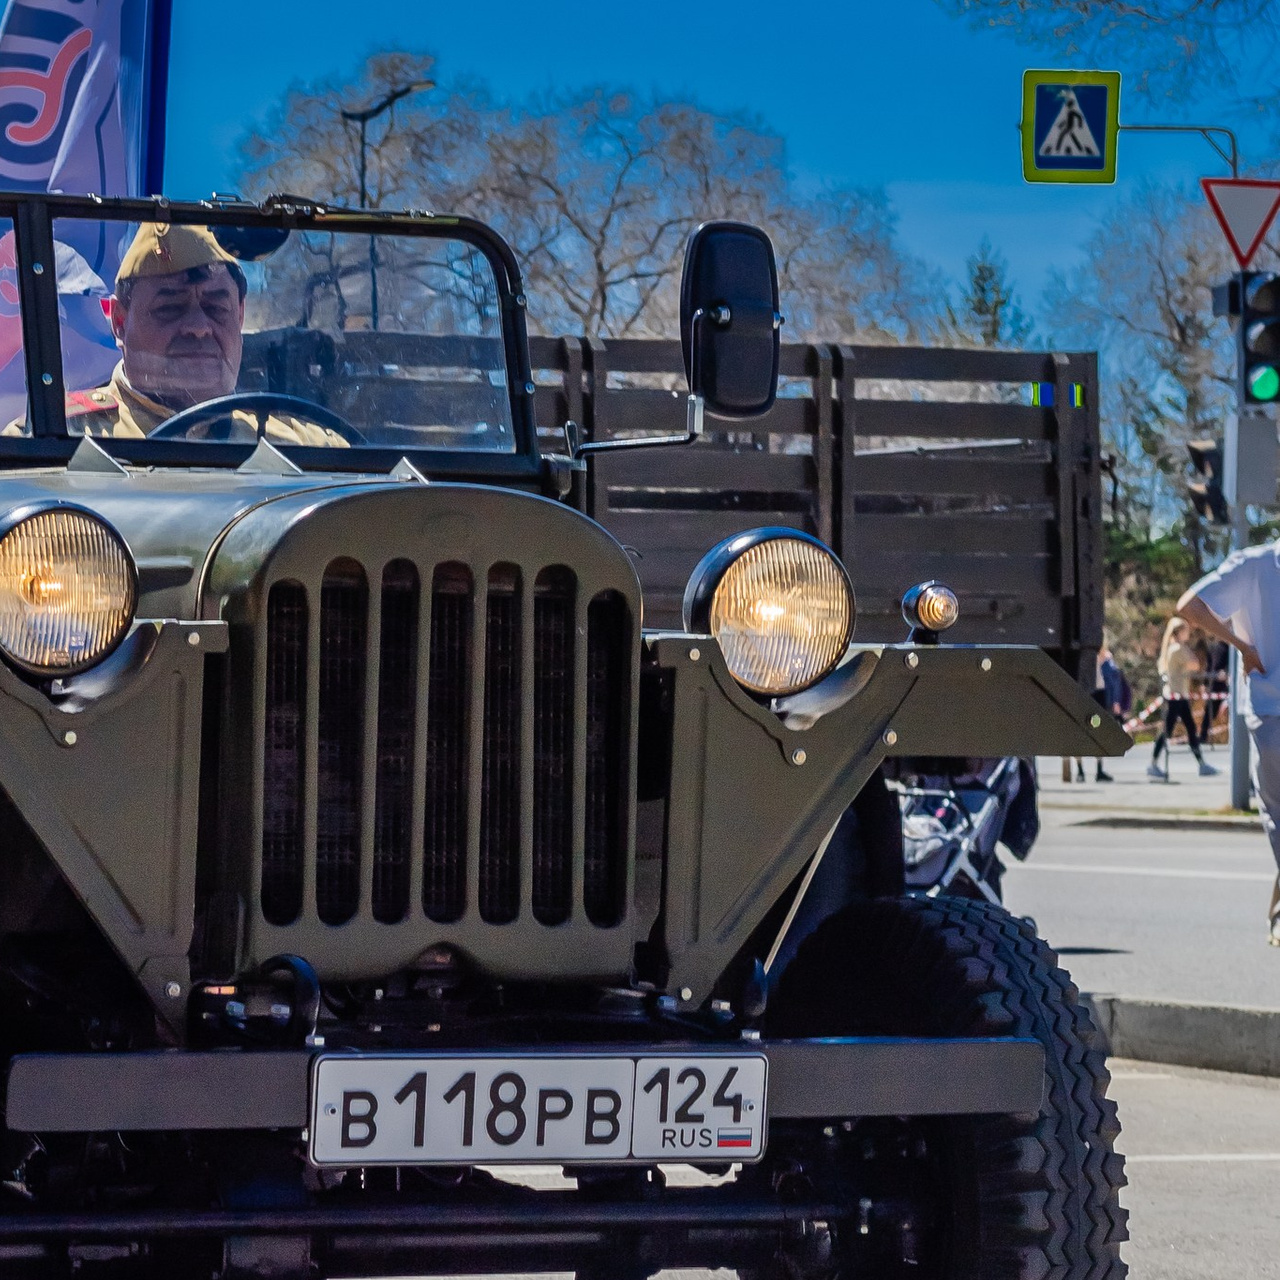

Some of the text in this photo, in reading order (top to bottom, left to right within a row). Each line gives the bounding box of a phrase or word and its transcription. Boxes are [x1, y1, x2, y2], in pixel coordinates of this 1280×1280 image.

[340, 1066, 744, 1149] В118РВ 124
[662, 1127, 713, 1149] RUS
